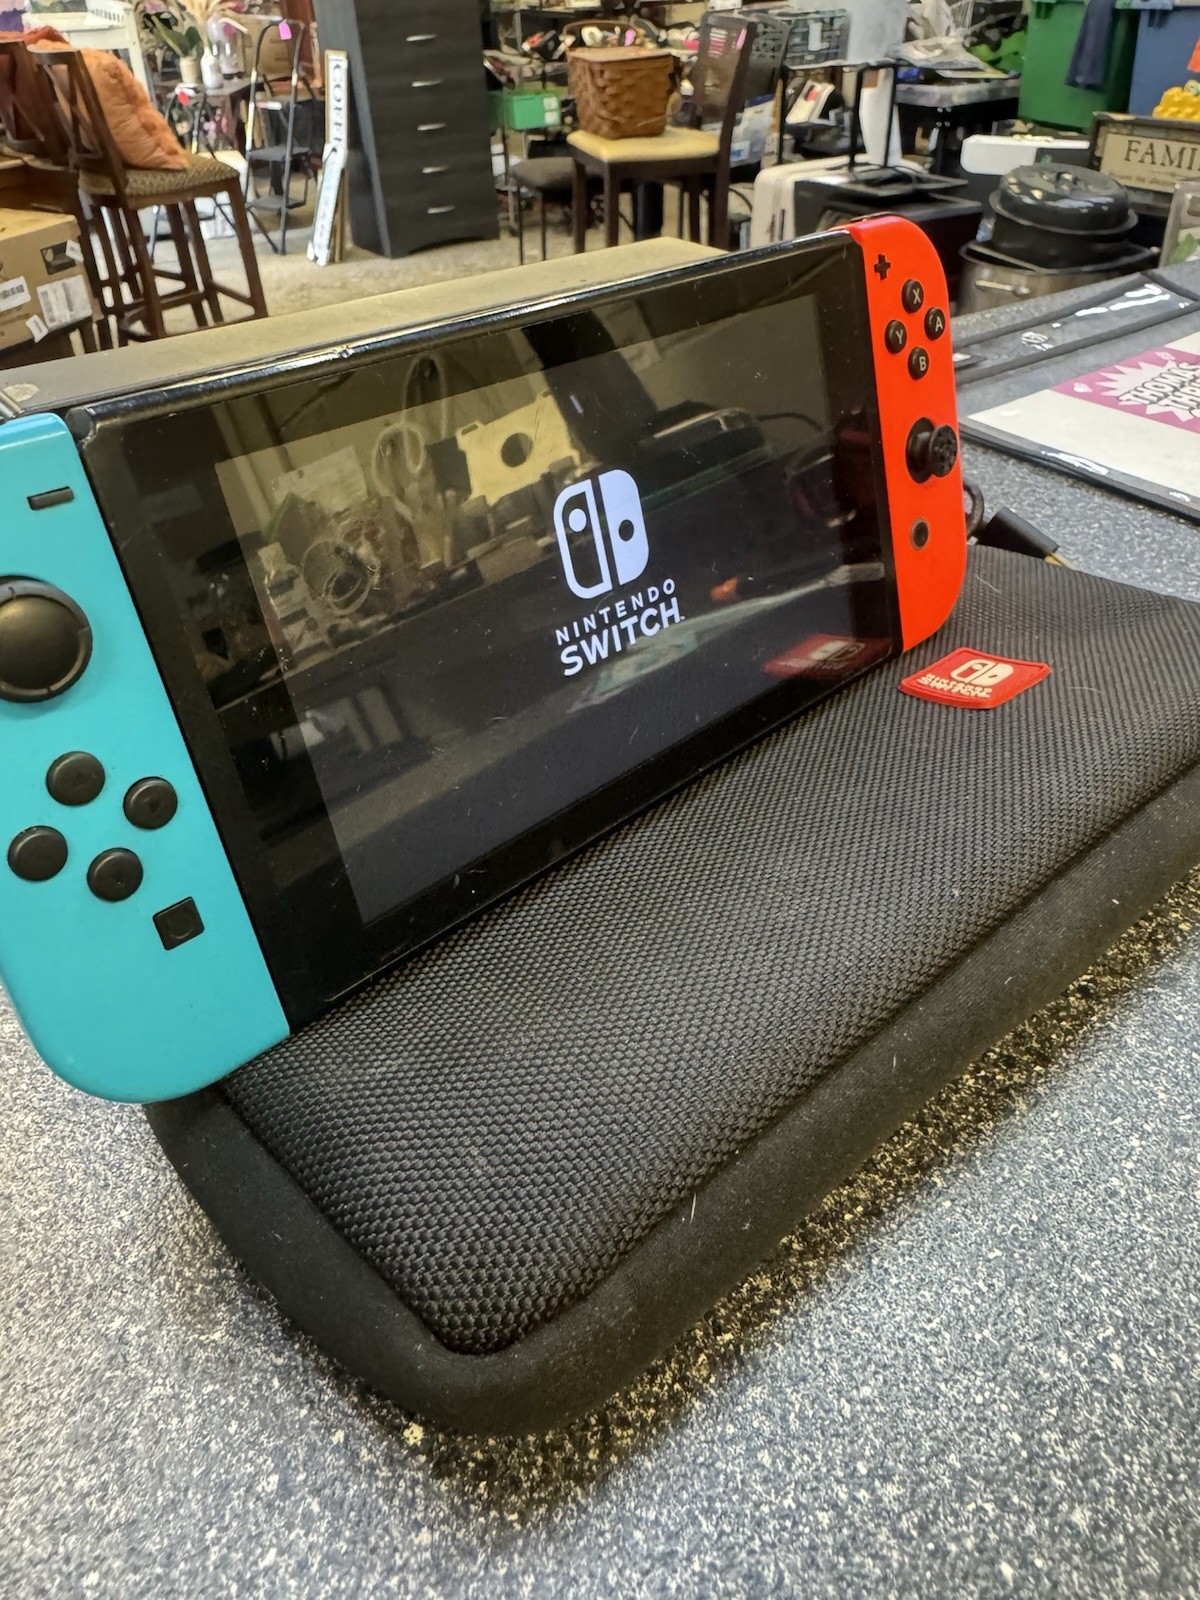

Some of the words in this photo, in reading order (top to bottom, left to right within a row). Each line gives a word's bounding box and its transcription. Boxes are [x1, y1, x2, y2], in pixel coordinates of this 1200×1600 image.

[1124, 140, 1200, 171] FAMI
[912, 288, 921, 304] X
[934, 316, 943, 332] A
[895, 329, 904, 344] Y
[919, 356, 927, 371] B
[555, 578, 676, 646] NINTENDO
[560, 596, 682, 676] SWITCH
